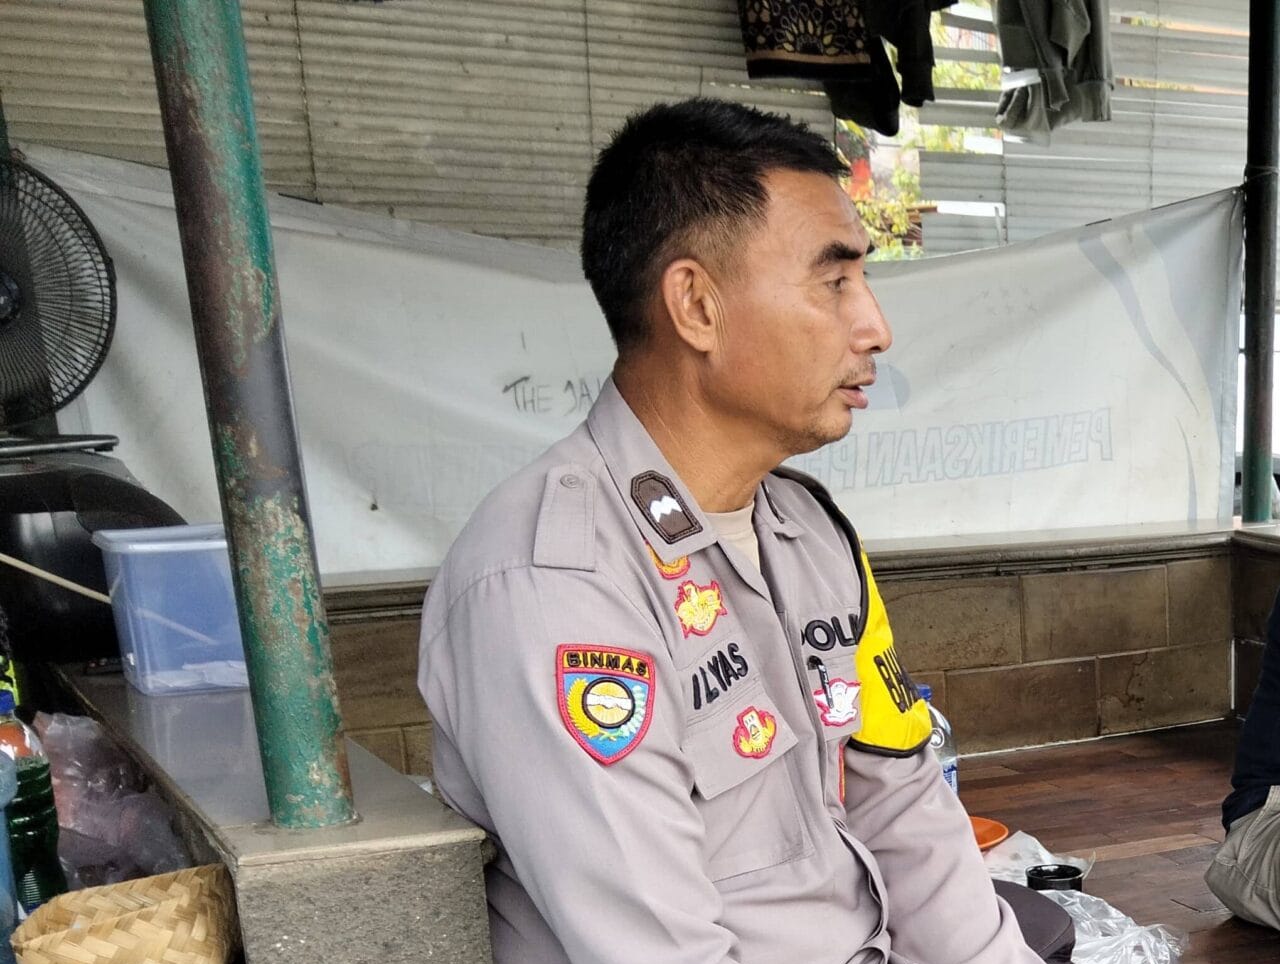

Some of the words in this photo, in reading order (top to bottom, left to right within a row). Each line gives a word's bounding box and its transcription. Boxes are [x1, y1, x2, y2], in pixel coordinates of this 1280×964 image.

[502, 375, 552, 414] THE
[566, 651, 648, 676] BINMAS
[691, 642, 749, 711] ILYAS
